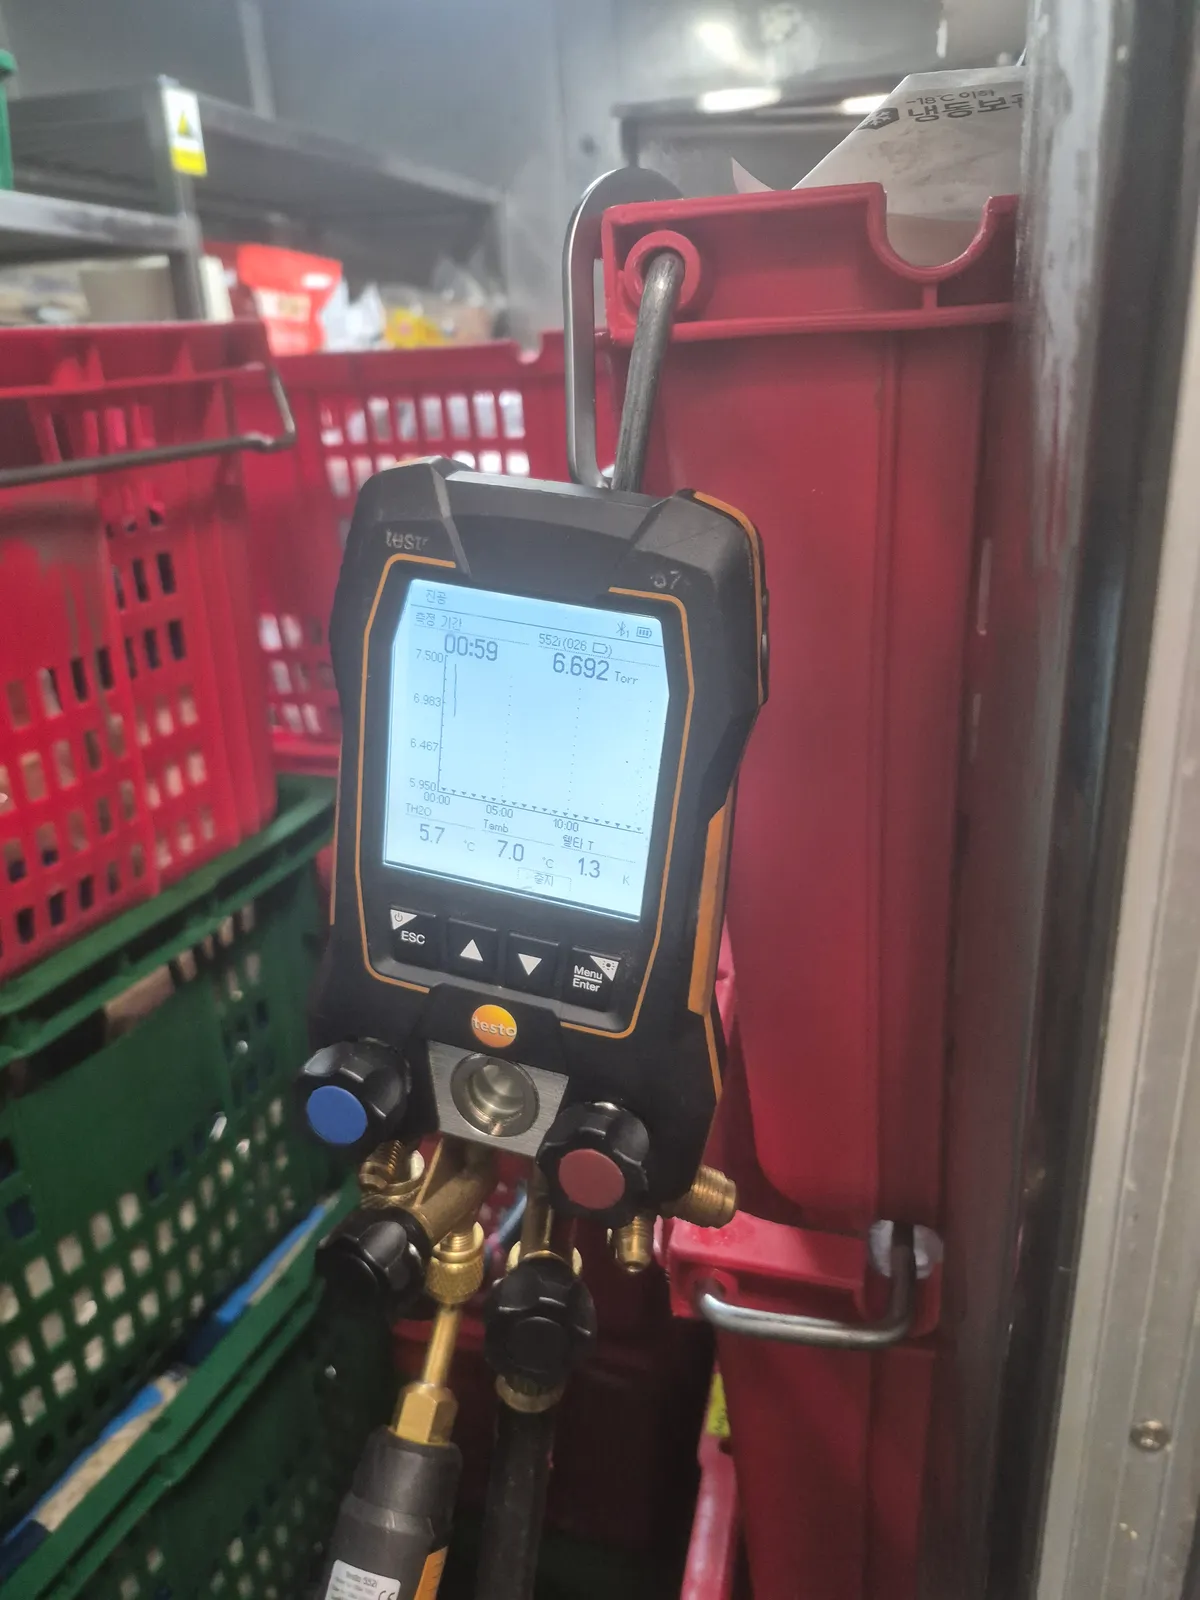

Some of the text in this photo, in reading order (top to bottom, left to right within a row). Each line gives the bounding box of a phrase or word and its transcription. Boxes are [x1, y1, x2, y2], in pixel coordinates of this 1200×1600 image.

[426, 589, 447, 605] 진공
[415, 612, 463, 631] 측정 기간
[443, 633, 499, 661] 00:59
[415, 648, 444, 664] 7.500
[552, 653, 639, 686] 6.692 Torr
[413, 692, 442, 708] 6.983
[410, 738, 439, 752] 6.467
[409, 777, 437, 792] 5.950
[423, 792, 451, 806] 00:00
[485, 804, 514, 819] 05:00
[483, 819, 509, 833] Tamb
[553, 818, 580, 833] 10:00
[419, 823, 445, 844] 5.7
[496, 840, 525, 862] 7.0
[587, 840, 595, 851] T
[577, 857, 631, 886] 1.3 K
[400, 930, 426, 945] ESC
[574, 965, 603, 980] Menu
[572, 978, 601, 993] Enter
[471, 1015, 518, 1037] testo
